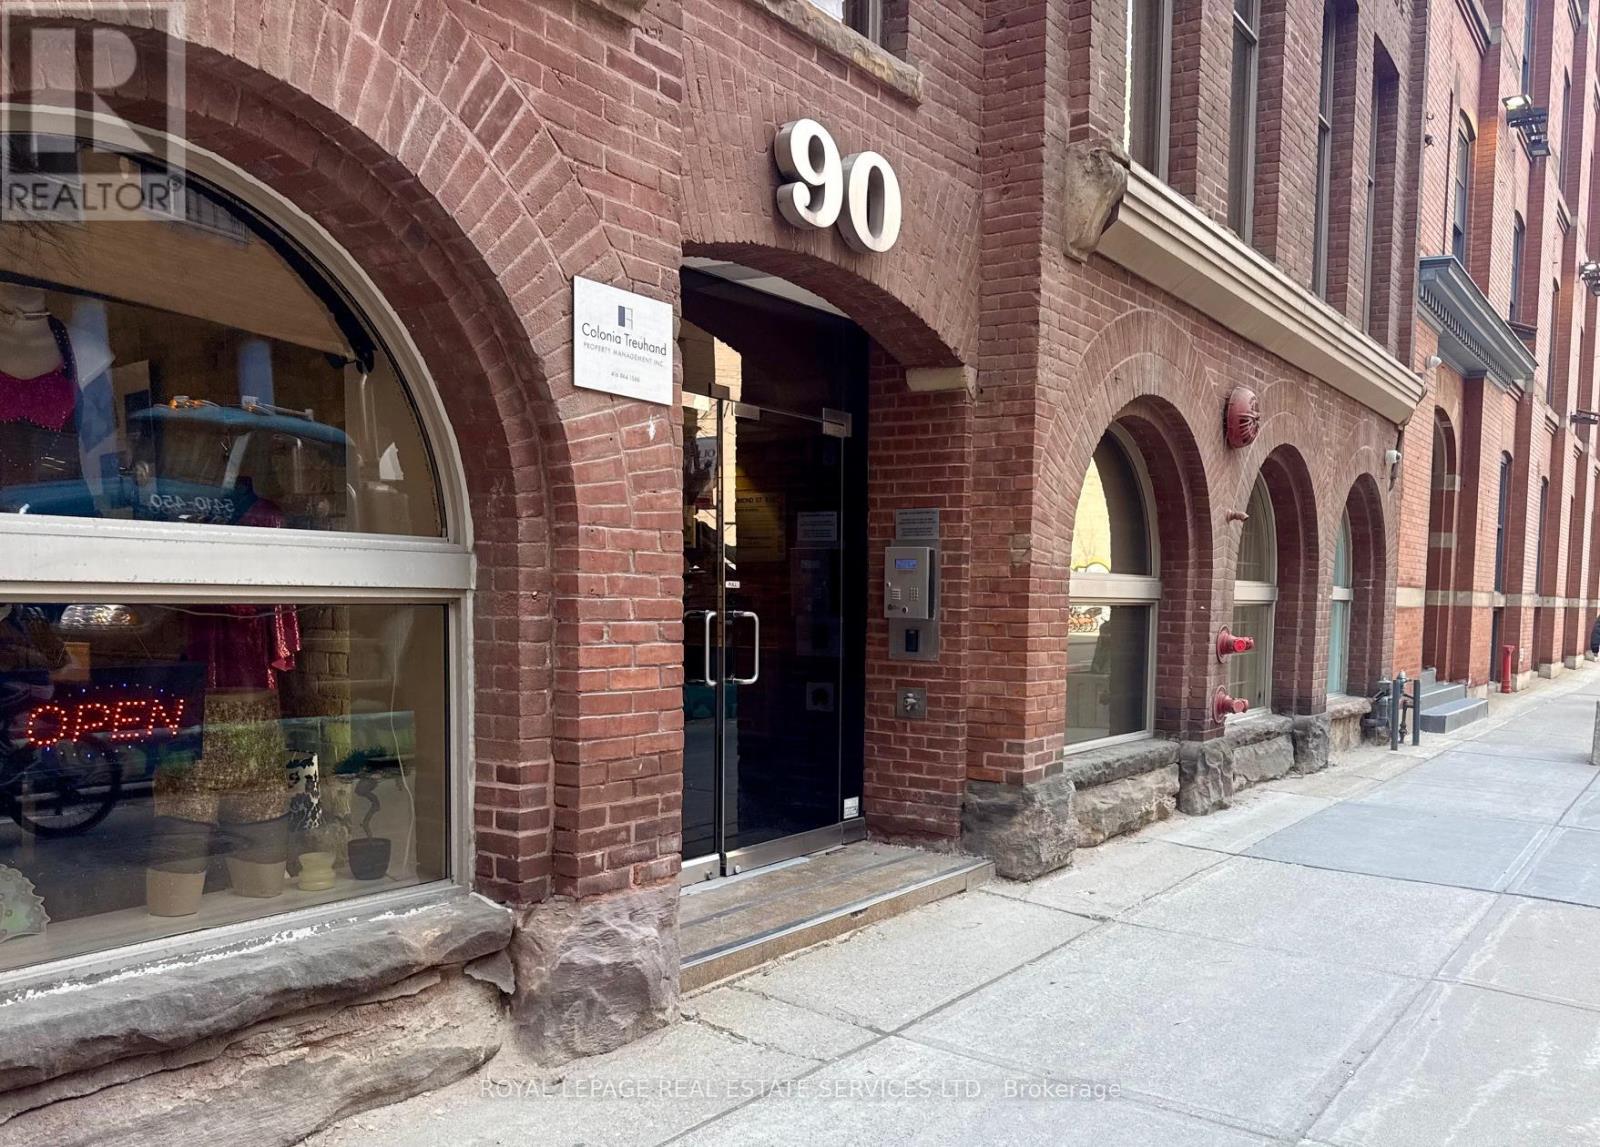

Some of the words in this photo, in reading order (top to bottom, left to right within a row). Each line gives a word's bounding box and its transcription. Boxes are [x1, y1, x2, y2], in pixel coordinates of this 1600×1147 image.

[774, 118, 902, 253] 90
[581, 322, 622, 344] Colonia
[624, 333, 667, 356] Treuhand
[583, 341, 611, 353] PROPERTY
[613, 349, 652, 364] MANAGEMENT
[27, 698, 185, 745] OPEN
